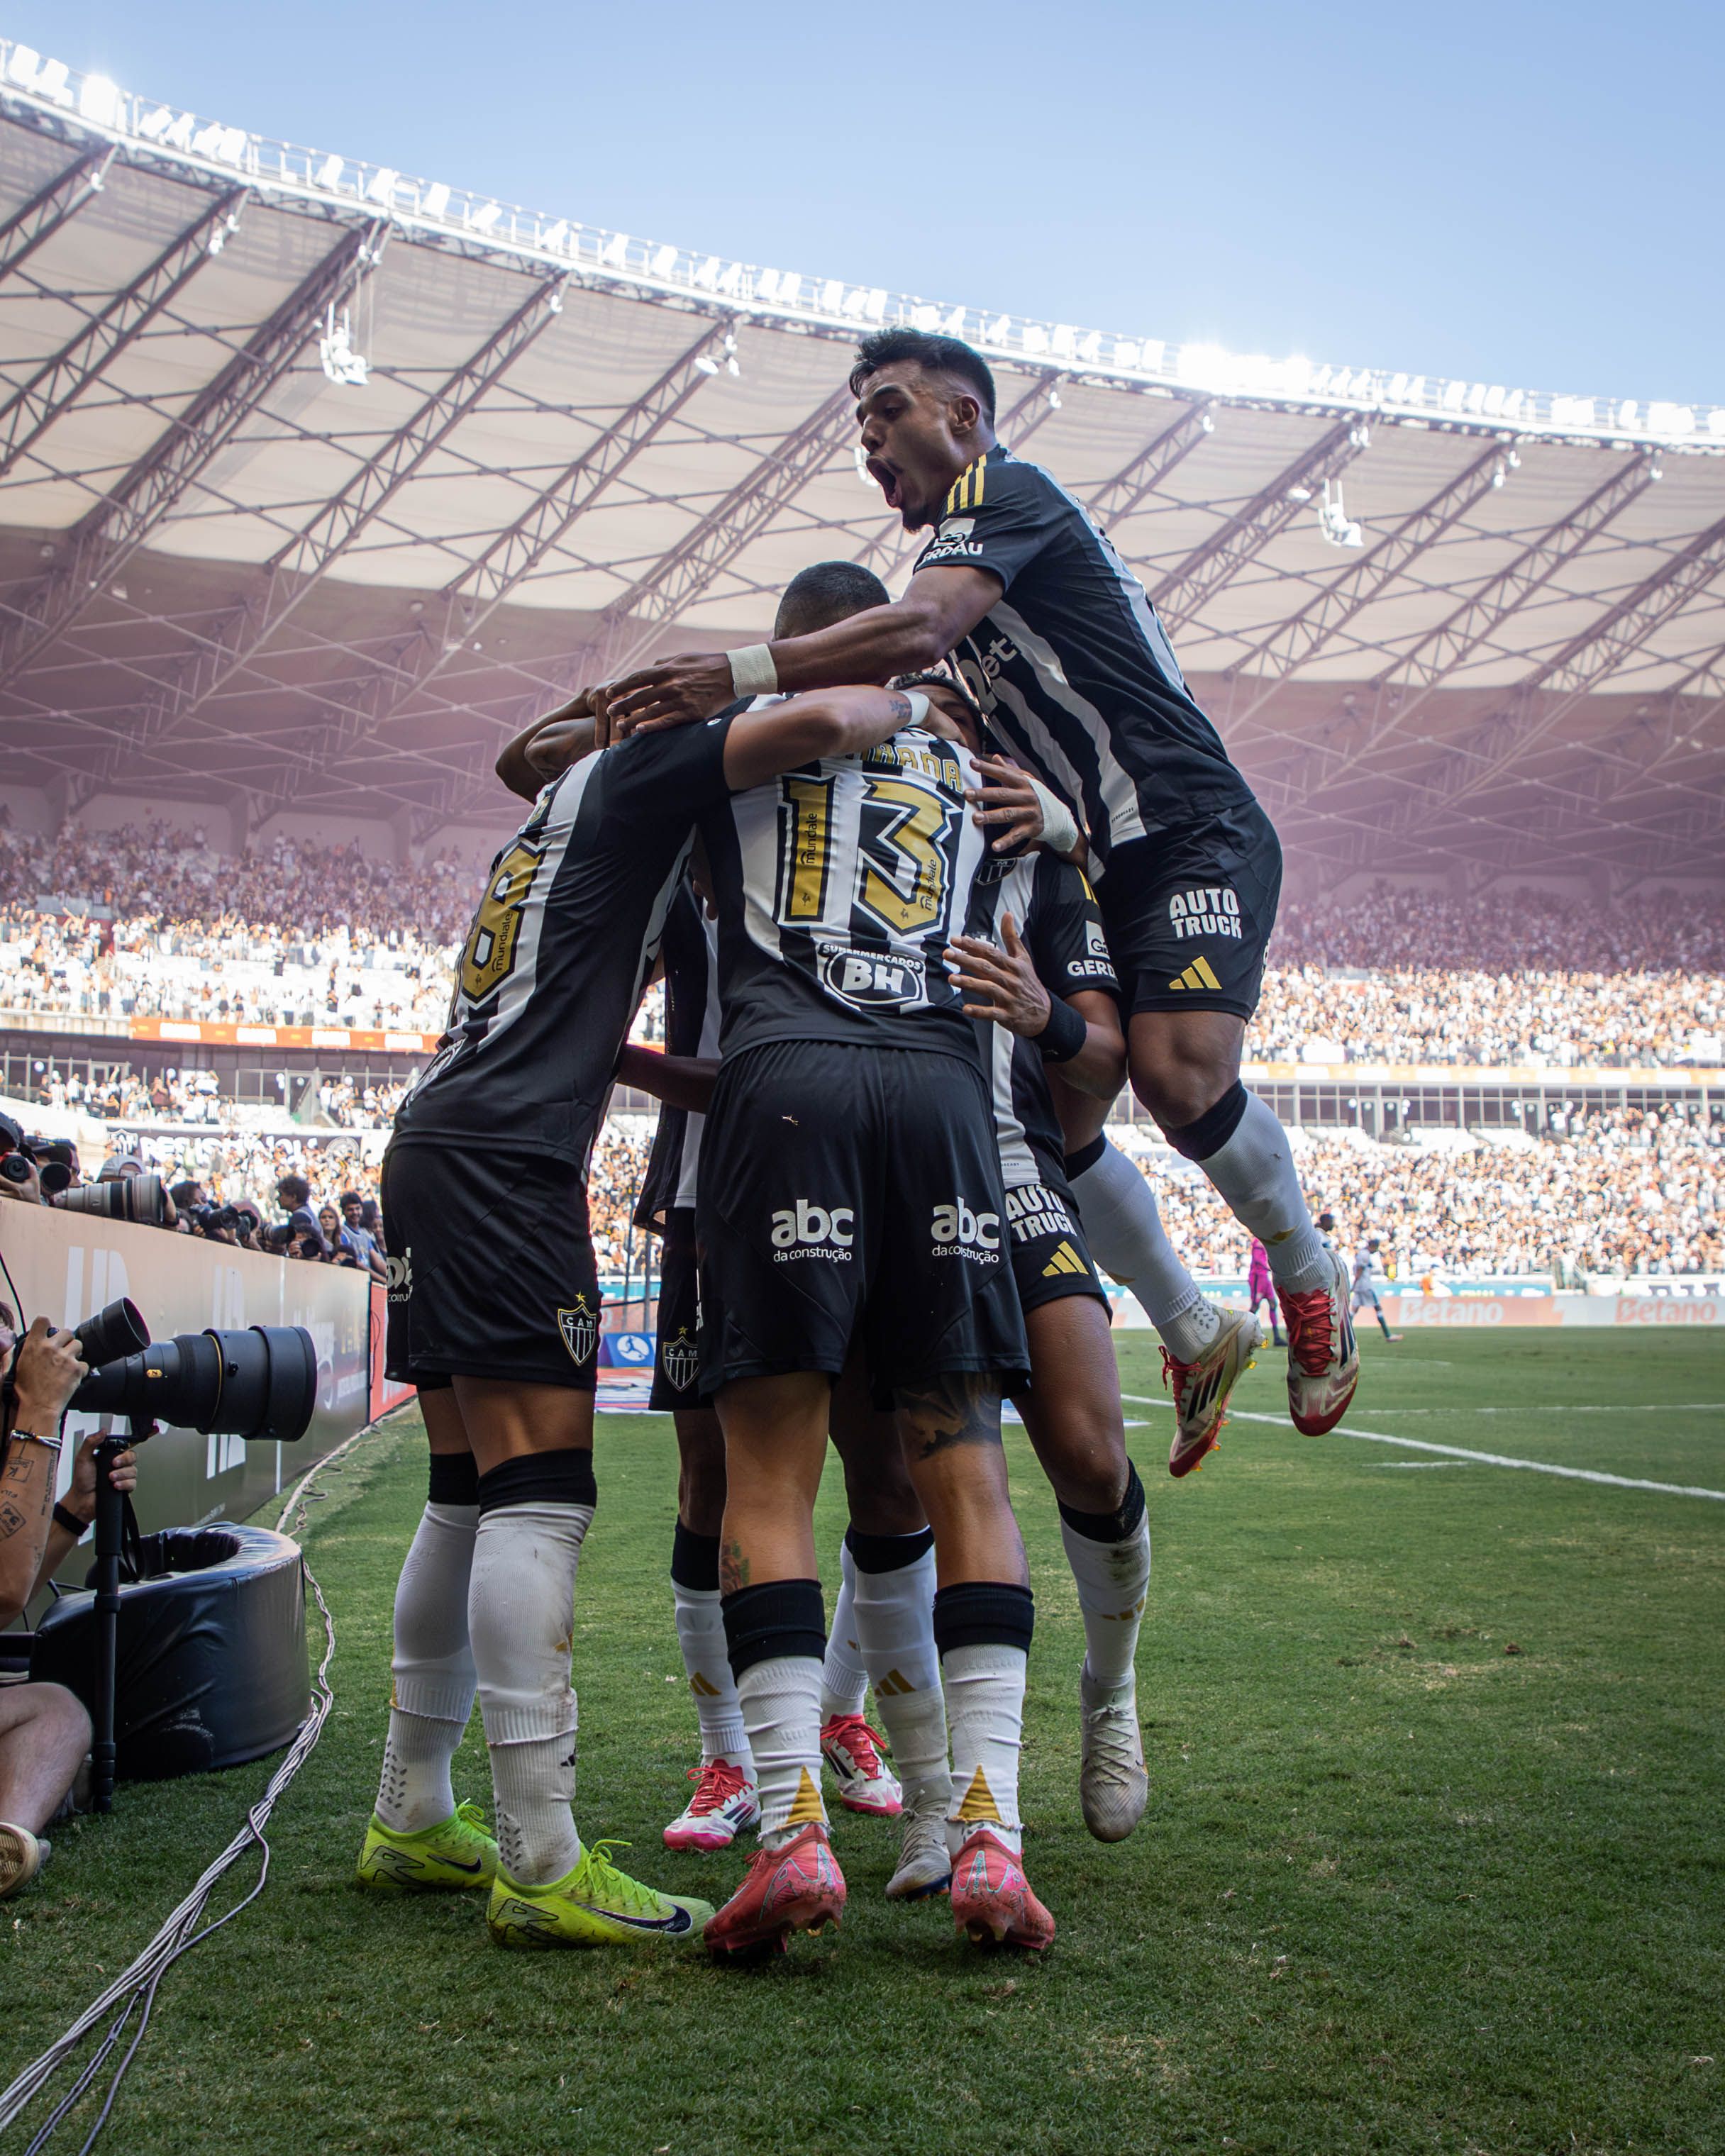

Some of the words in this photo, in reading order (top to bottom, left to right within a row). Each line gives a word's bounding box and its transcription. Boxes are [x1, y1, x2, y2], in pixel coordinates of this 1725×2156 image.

[779, 773, 959, 935] 13
[1170, 888, 1240, 921] AUTO
[1172, 913, 1242, 940] TRUCK
[492, 913, 513, 972] mundiale
[842, 957, 904, 994] BH
[1067, 960, 1118, 982] GERD
[771, 1199, 853, 1248] abc
[931, 1196, 999, 1249] abc
[773, 1250, 788, 1262] da
[789, 1246, 852, 1264] construção
[932, 1245, 948, 1256] da
[566, 1316, 593, 1328] CAM
[1399, 1299, 1504, 1324] Betano
[1614, 1298, 1718, 1323] Betano
[668, 1348, 697, 1357] CAM
